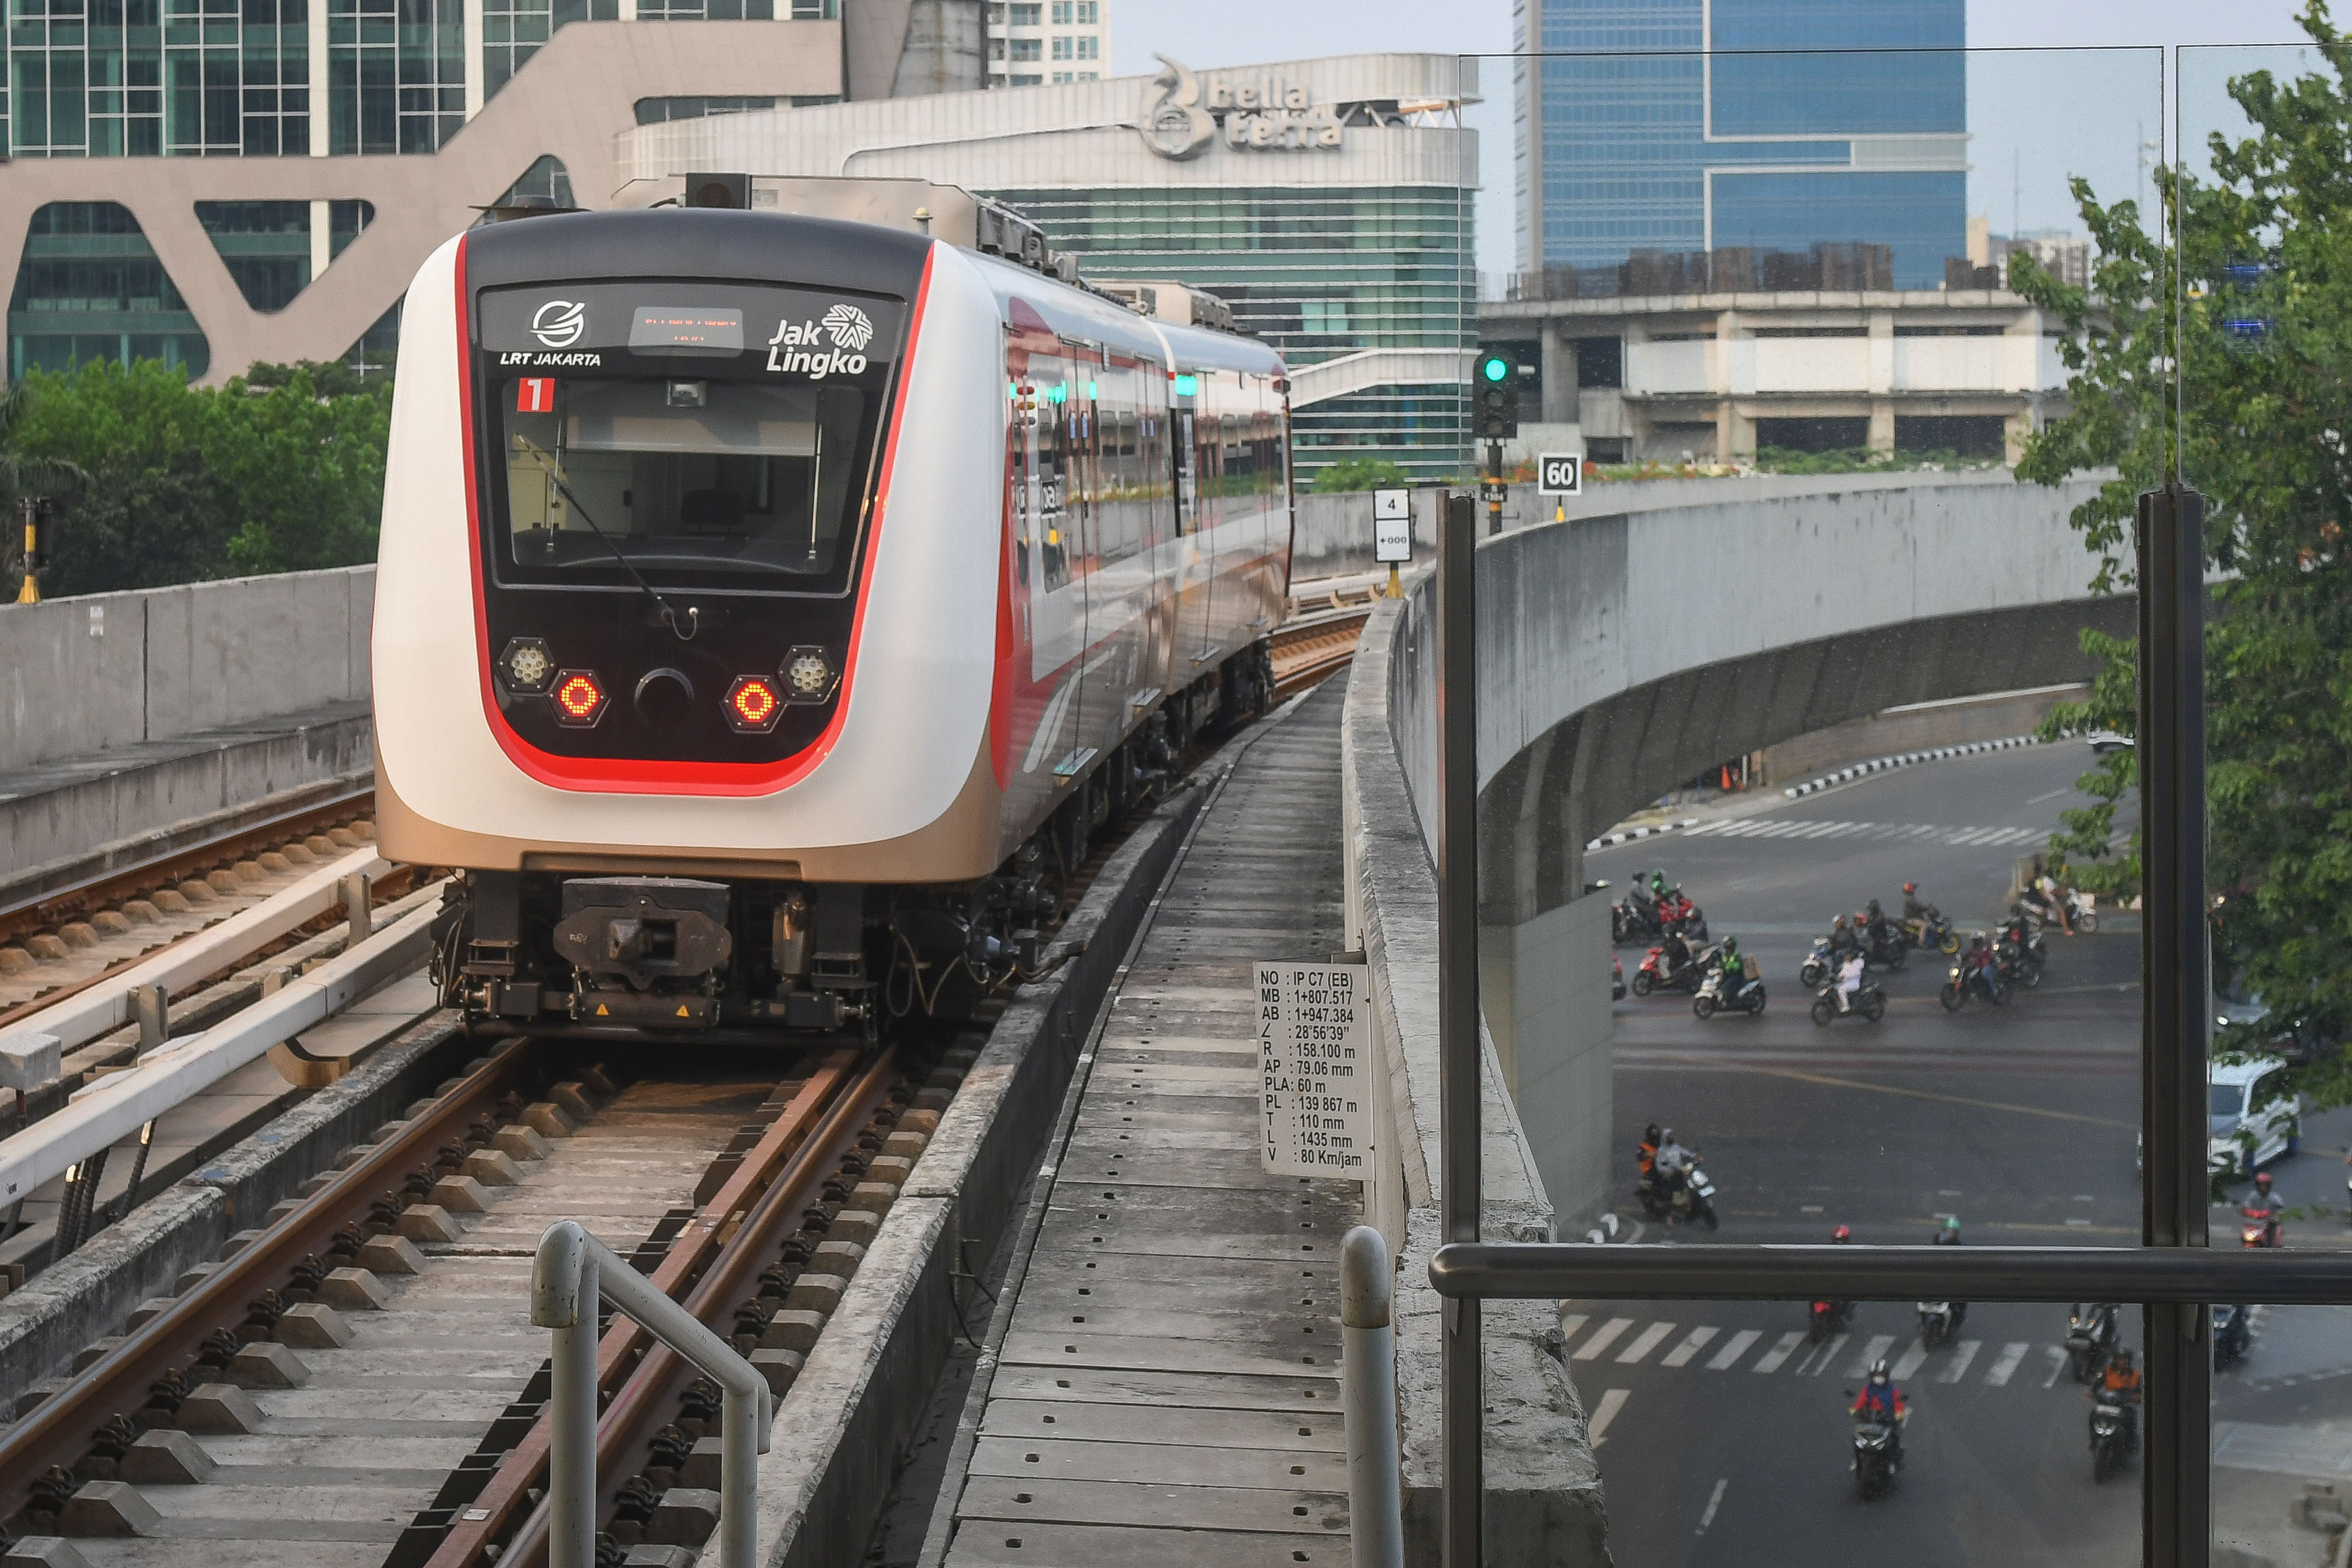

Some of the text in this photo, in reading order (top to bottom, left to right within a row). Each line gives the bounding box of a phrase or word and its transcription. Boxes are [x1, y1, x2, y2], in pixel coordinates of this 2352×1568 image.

[766, 319, 823, 346] Jak
[500, 352, 600, 366] LRT JAKARTA
[766, 345, 867, 379] Lingko
[527, 379, 542, 410] 1
[1547, 462, 1573, 486] 60
[1388, 498, 1396, 510] 4
[1261, 971, 1279, 985] NO
[1293, 971, 1305, 986] IP
[1308, 972, 1324, 987] C7
[1328, 972, 1353, 991] (EB)
[1261, 988, 1280, 1002] MB
[1294, 989, 1353, 1005] 1+807.517
[1261, 1006, 1279, 1021] AB
[1295, 1007, 1354, 1024] 1+947.384
[1263, 1041, 1272, 1055] R
[1296, 1042, 1341, 1058] 158.100
[1344, 1048, 1355, 1059] m
[1264, 1059, 1281, 1074] AP
[1297, 1060, 1328, 1075] 79.06
[1331, 1065, 1353, 1077] mm
[1298, 1078, 1312, 1093] 60
[1315, 1082, 1326, 1094] m
[1265, 1094, 1282, 1109] PL
[1346, 1101, 1357, 1113] m
[1265, 1111, 1274, 1126] T
[1299, 1113, 1319, 1129] 110
[1322, 1118, 1345, 1130] mm
[1267, 1129, 1275, 1144] L
[1300, 1131, 1328, 1147] 1435
[1331, 1136, 1352, 1148] mm
[1267, 1146, 1277, 1161] V
[1301, 1148, 1315, 1164] 80
[1318, 1149, 1362, 1169] Km/jam
